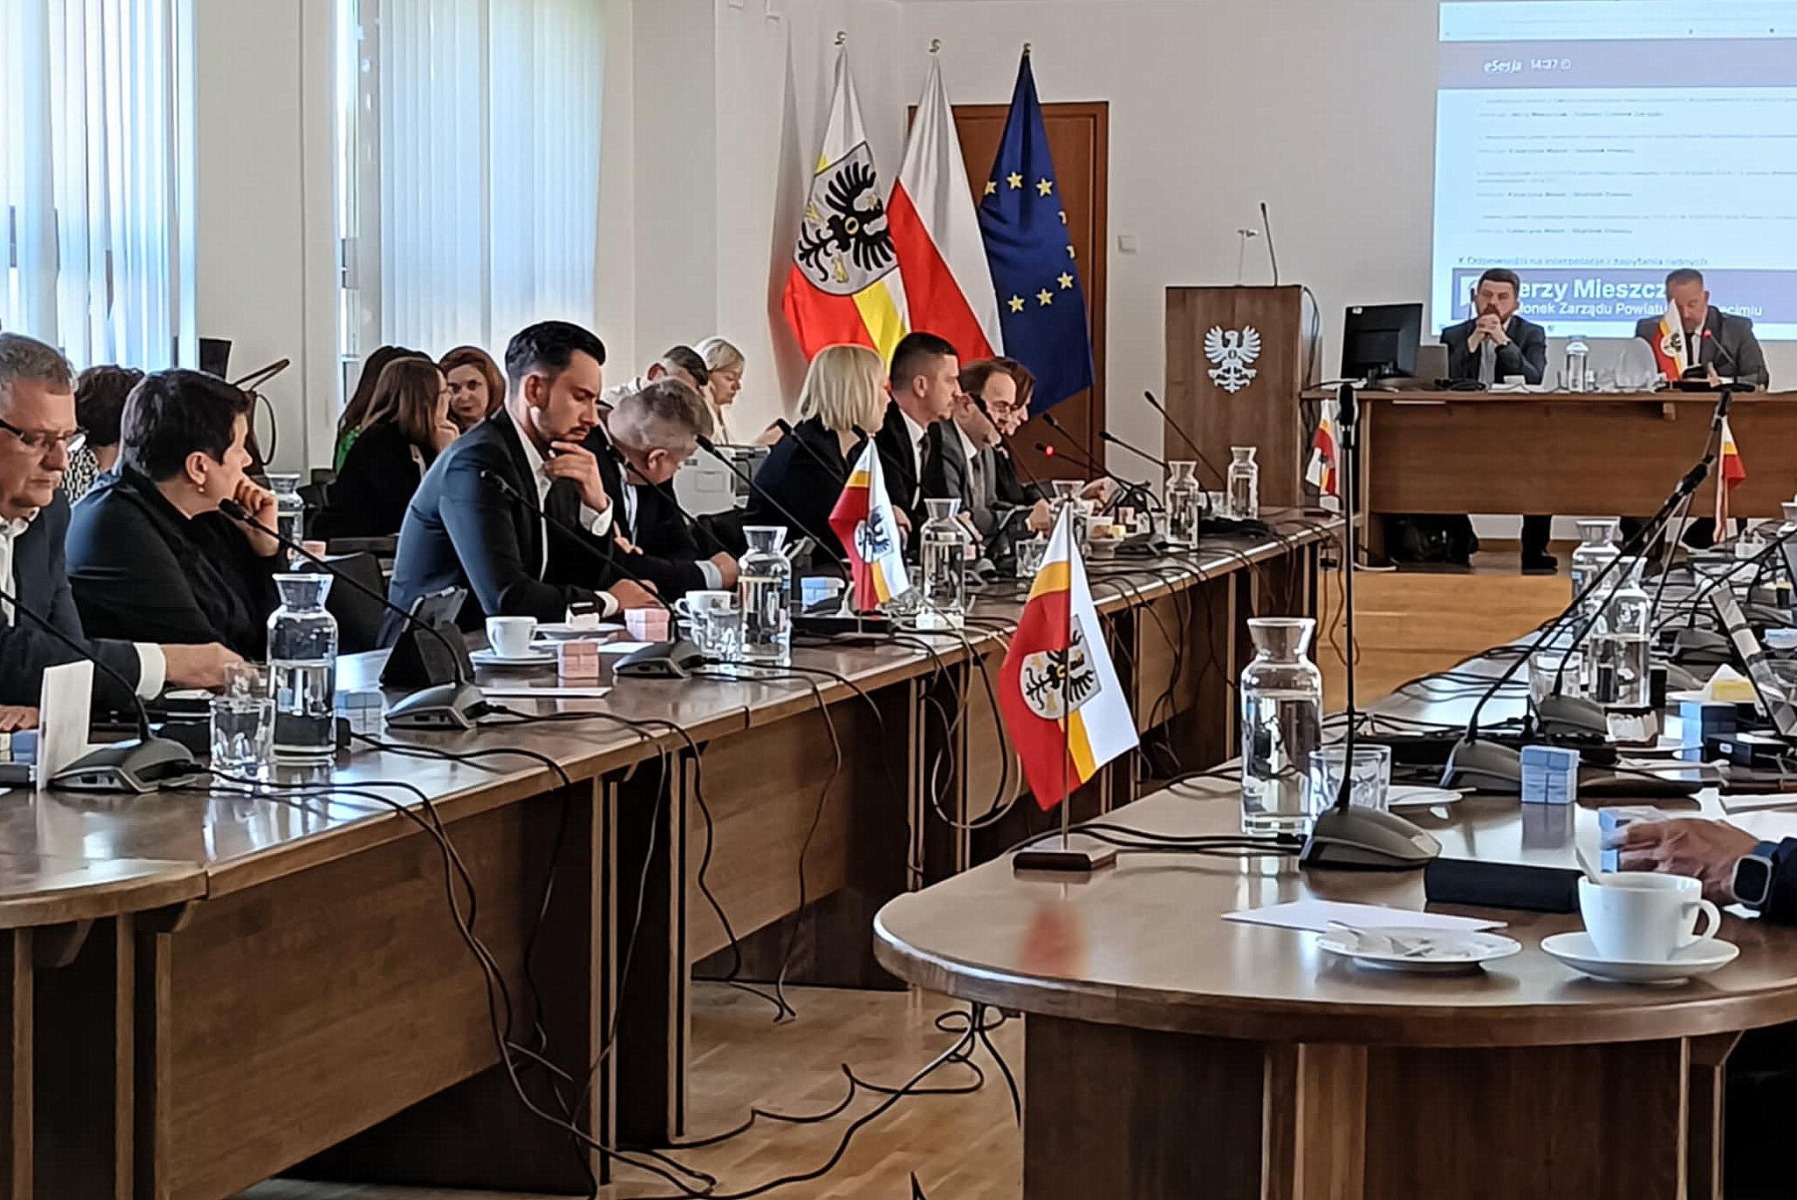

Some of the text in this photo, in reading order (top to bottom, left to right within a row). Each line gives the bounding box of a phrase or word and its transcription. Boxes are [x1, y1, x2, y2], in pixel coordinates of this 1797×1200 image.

[1519, 278, 1666, 302] erzy Mieszcz
[1559, 302, 1613, 317] Zarządu
